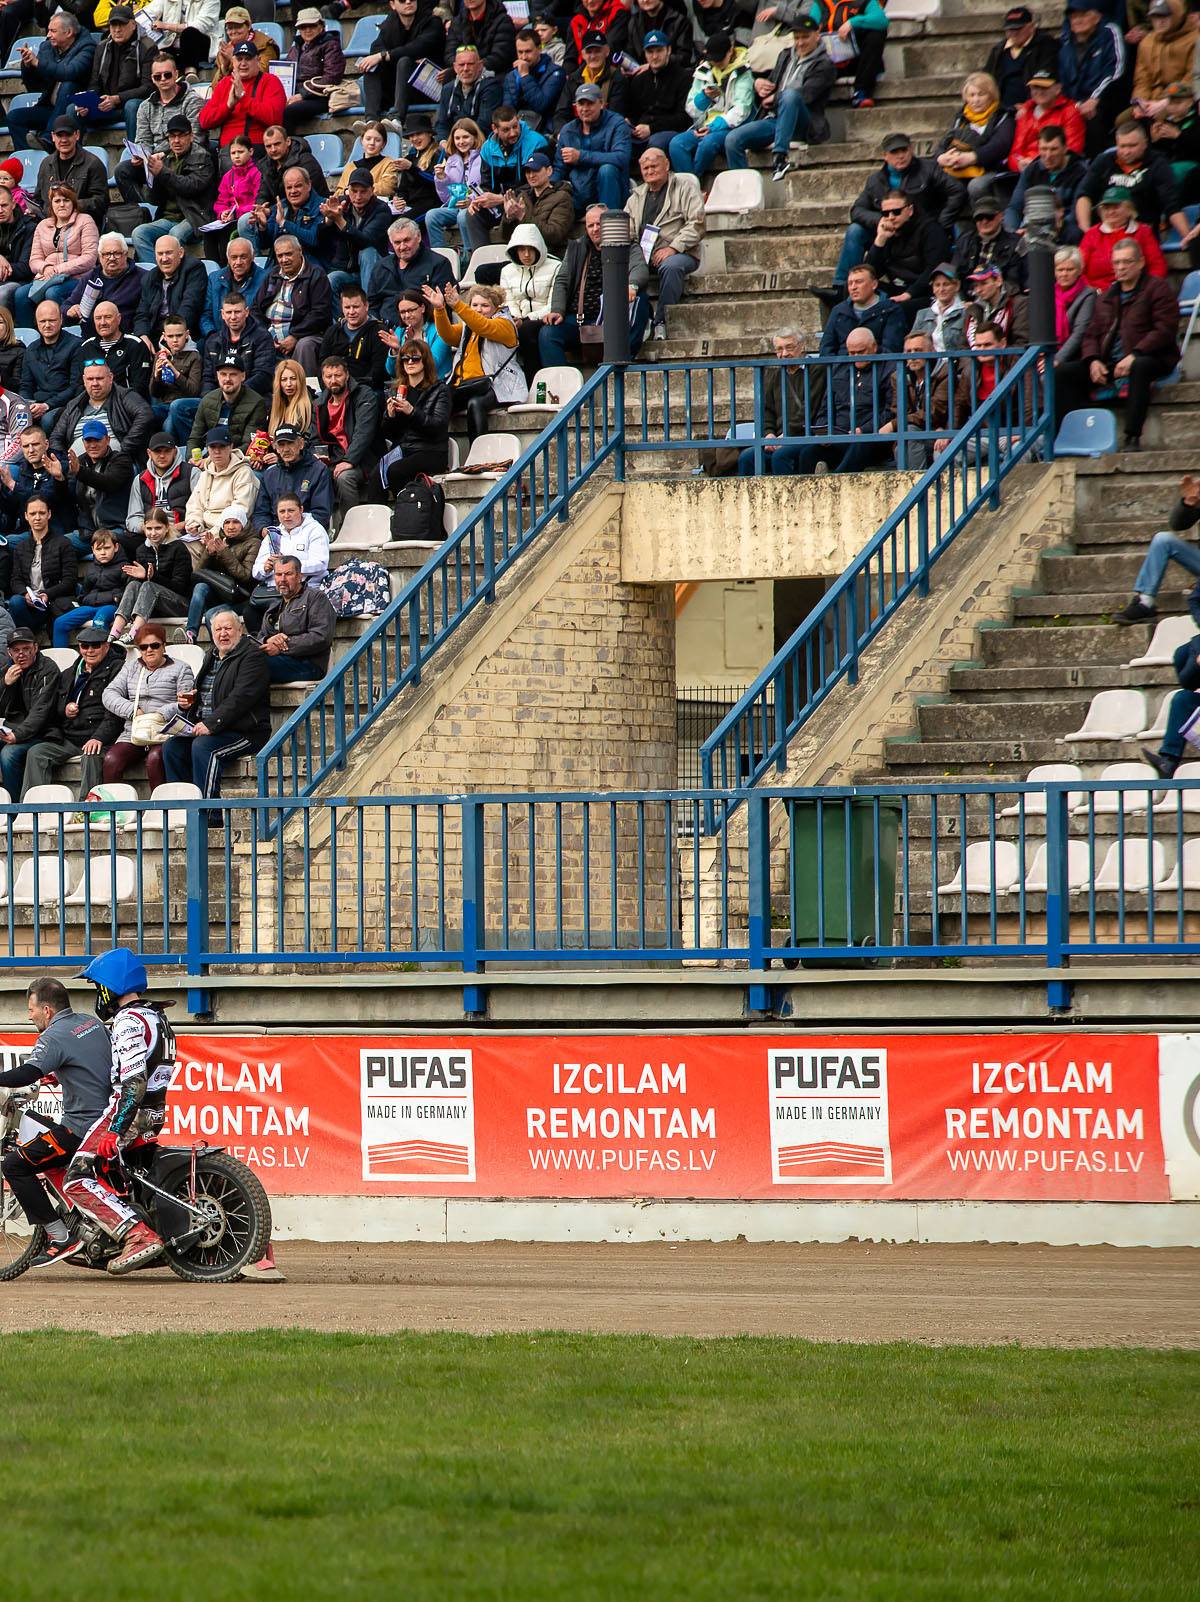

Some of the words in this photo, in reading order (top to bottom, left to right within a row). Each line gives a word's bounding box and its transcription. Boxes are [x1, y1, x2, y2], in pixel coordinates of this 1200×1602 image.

[761, 273, 778, 289] 10
[701, 340, 709, 356] 9
[1086, 415, 1096, 428] 6
[1070, 671, 1079, 683] 4
[1013, 744, 1022, 759] 3
[947, 818, 956, 833] 2
[233, 830, 242, 844] 2
[167, 1060, 282, 1093] ZCILAM
[367, 1056, 466, 1089] PUFAS
[553, 1063, 687, 1094] IZCILAM
[775, 1056, 881, 1089] PUFAS
[972, 1061, 1113, 1094] IZCILAM
[160, 1105, 309, 1136] EMONTAM
[368, 1105, 397, 1119] MADE
[402, 1105, 412, 1119] IN
[416, 1105, 467, 1119] GERMANY
[526, 1107, 716, 1139] REMONTAM
[776, 1106, 806, 1120] MADE
[812, 1106, 822, 1120] IN
[828, 1106, 881, 1120] GERMANY
[945, 1107, 1144, 1140] REMONTAM
[528, 1149, 717, 1171] WWW.PUFAS.LV
[946, 1149, 1145, 1173] WWW.PUFAS.LV
